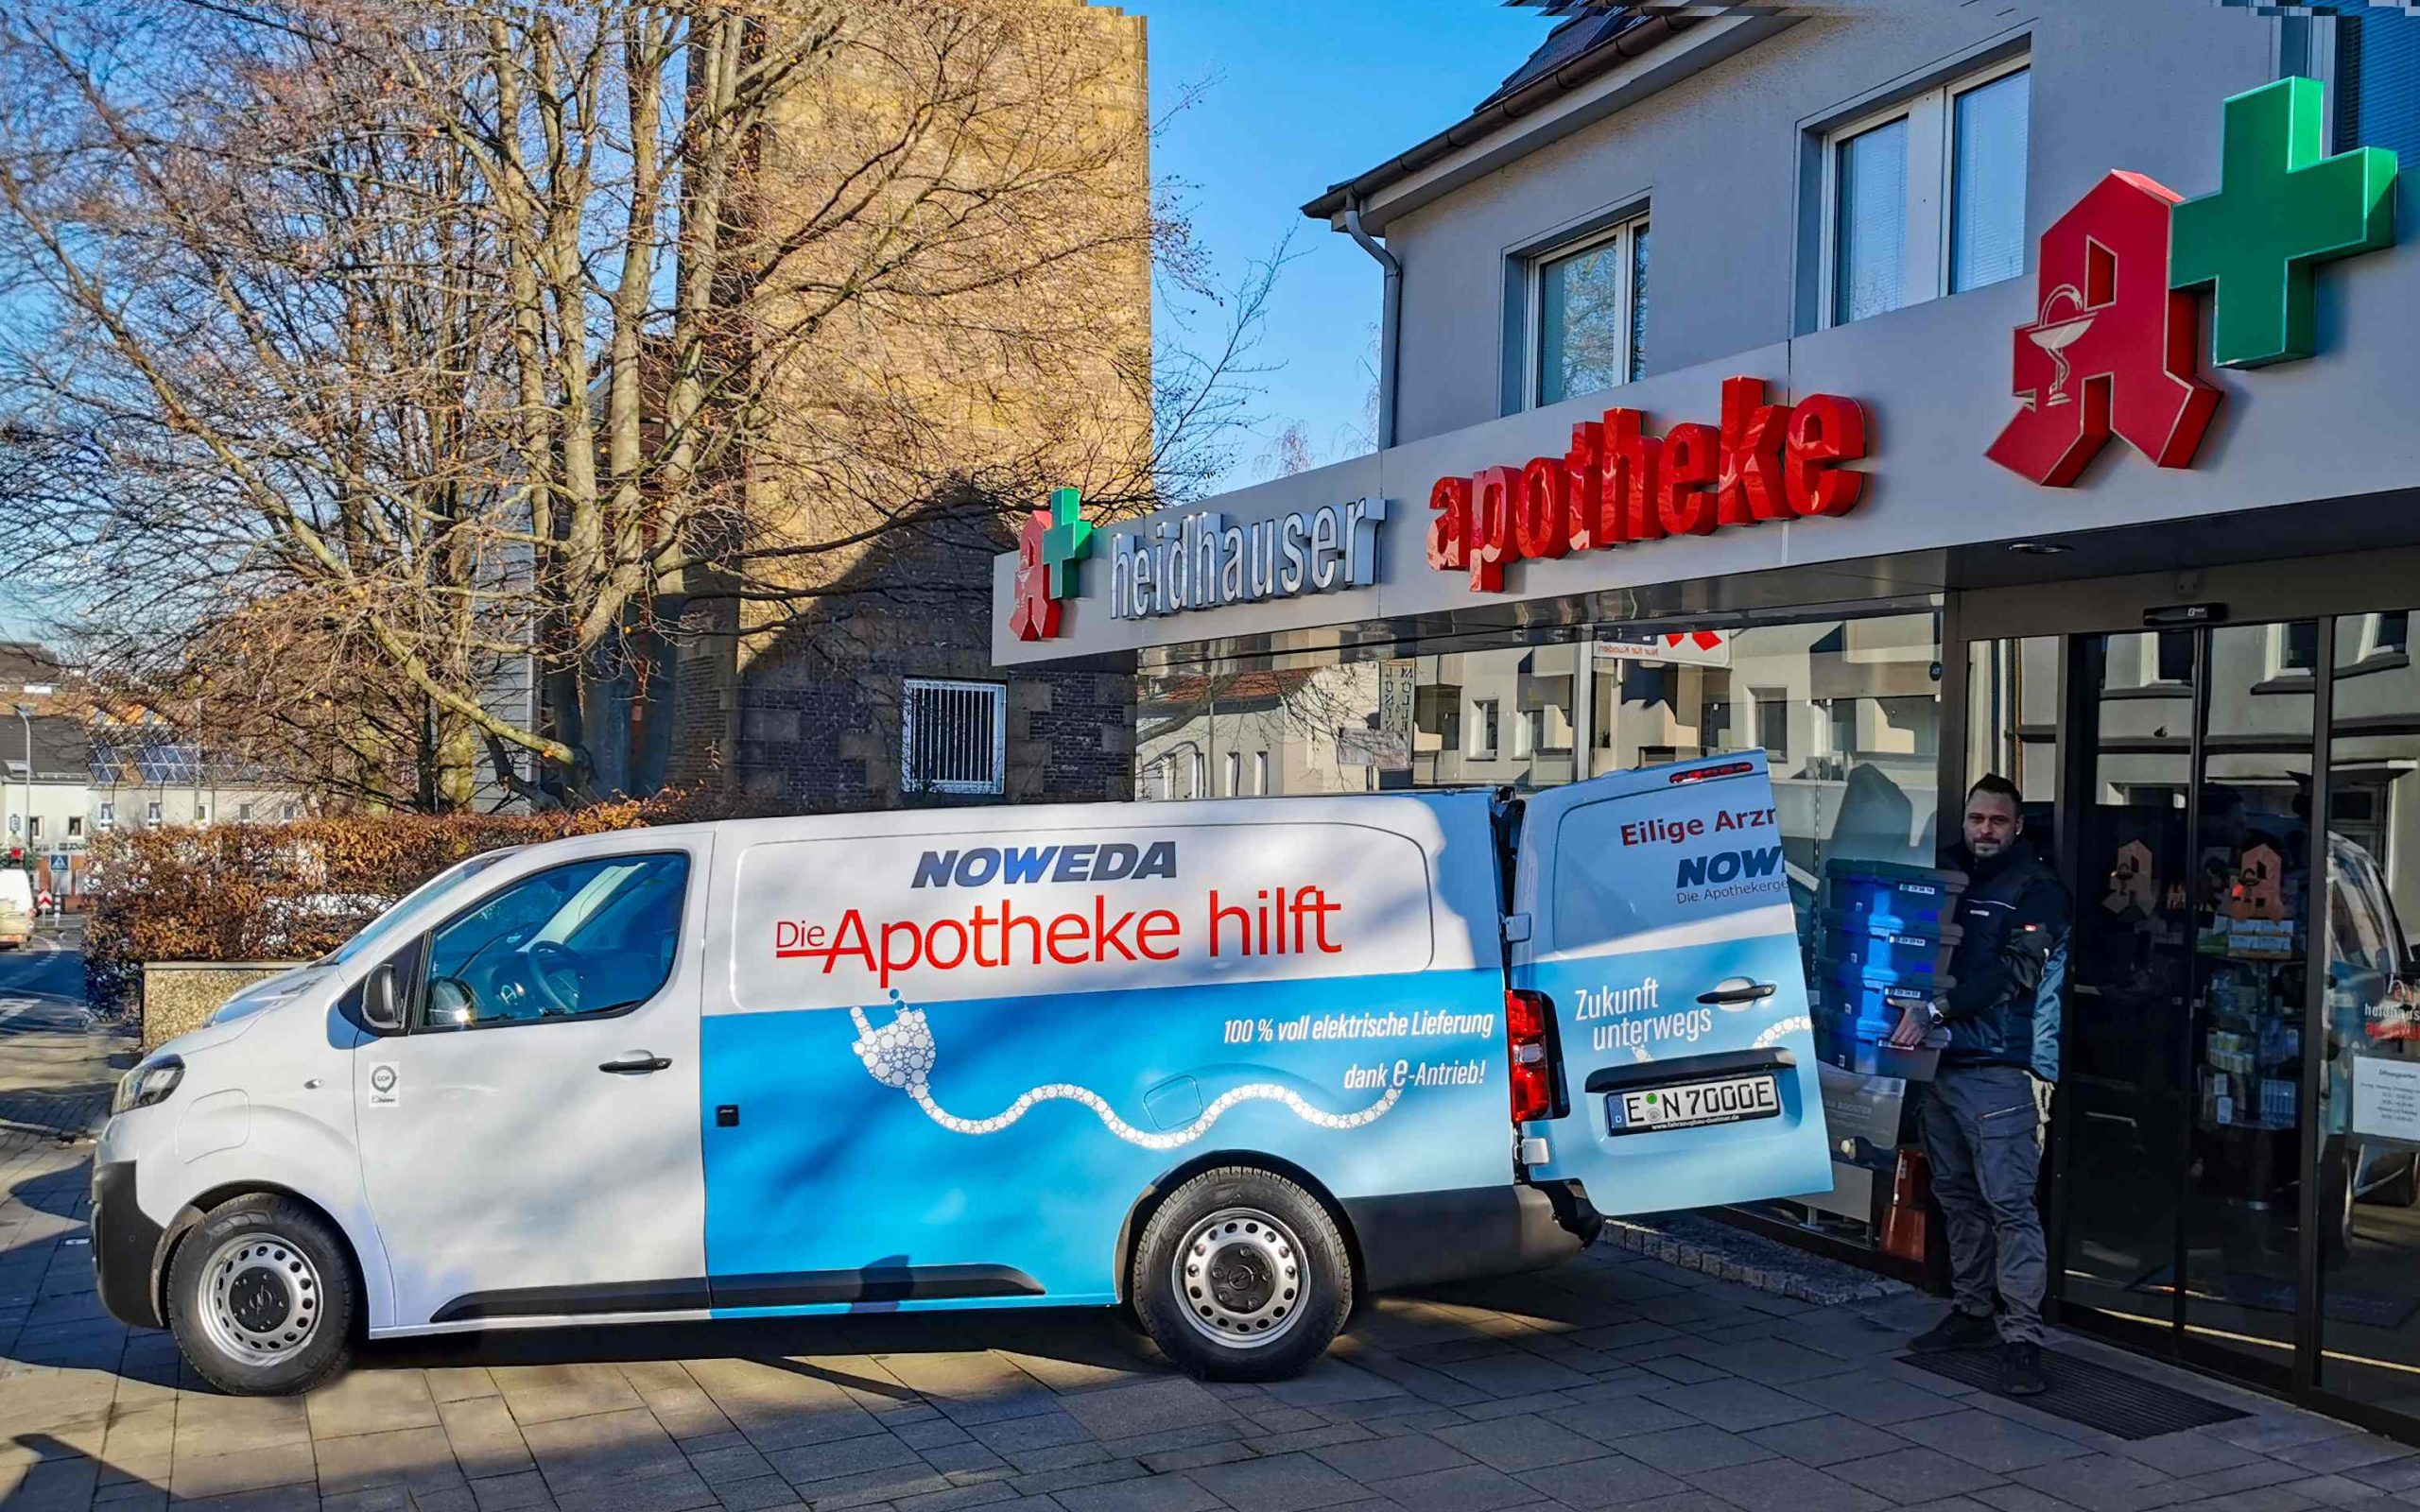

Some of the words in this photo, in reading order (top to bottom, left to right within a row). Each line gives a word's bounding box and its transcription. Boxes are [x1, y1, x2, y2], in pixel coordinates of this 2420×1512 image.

[1111, 497, 1385, 620] heidhauser
[1426, 375, 1865, 593] apotheke
[1620, 817, 1704, 847] Eilige
[910, 841, 1177, 889] NOWEDA
[1676, 845, 1786, 889] NOW
[1676, 891, 1700, 904] Die
[776, 919, 825, 949] Die
[821, 894, 1180, 989] Apotheke
[1209, 885, 1342, 957] hilft
[1575, 977, 1659, 1022] Zukunft
[1224, 1019, 1253, 1043] 100
[1257, 1018, 1273, 1042] %
[1278, 1015, 1310, 1041] voll
[1312, 1011, 1409, 1040] elektrische
[1411, 1009, 1494, 1039] Lieferung
[1593, 1007, 1712, 1051] unterwegs
[1344, 1062, 1388, 1089] dank
[1626, 1096, 1644, 1123] E
[1662, 1091, 1681, 1119] N
